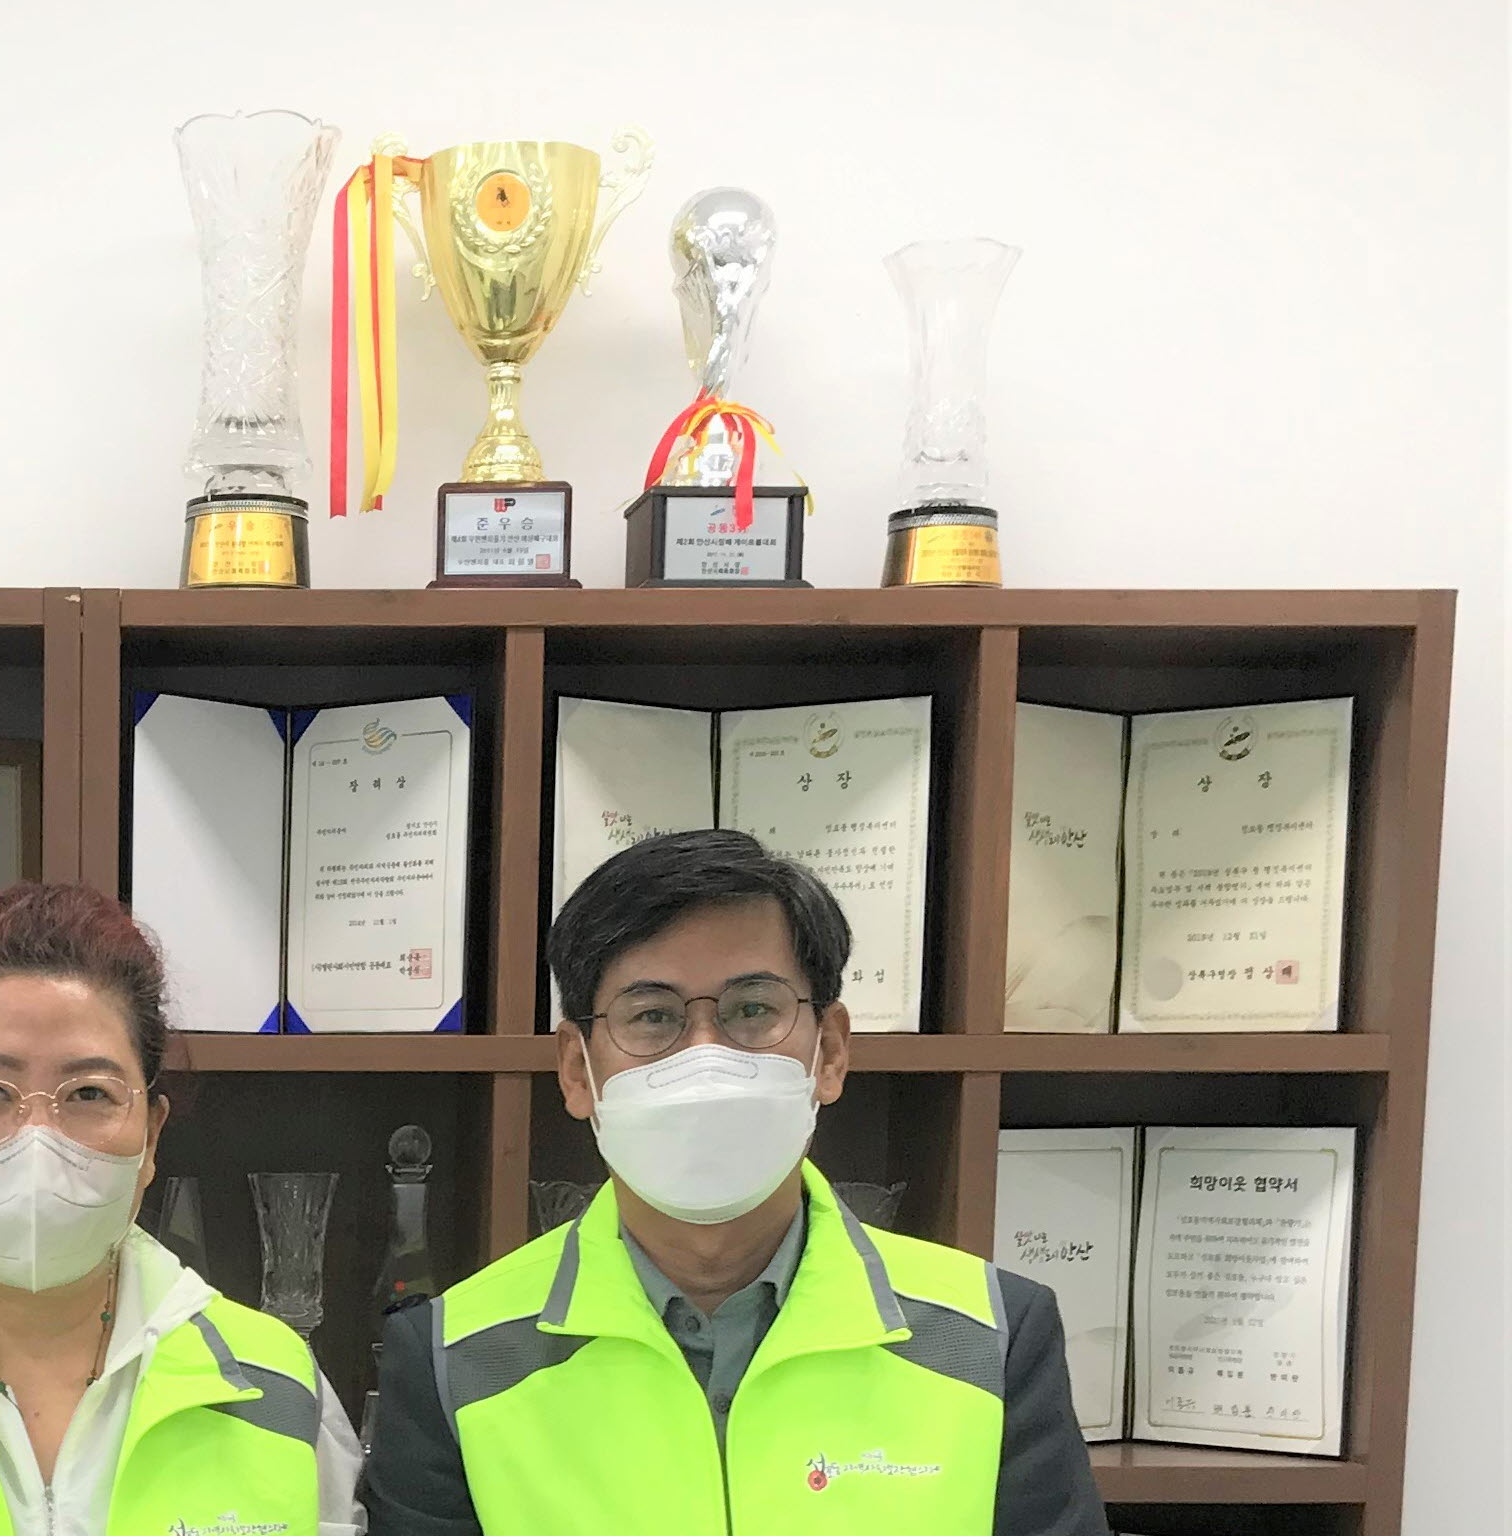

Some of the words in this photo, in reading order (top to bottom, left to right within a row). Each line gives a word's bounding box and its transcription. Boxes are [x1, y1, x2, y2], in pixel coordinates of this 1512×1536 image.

[1189, 1175, 1248, 1192] 희망이웃
[1253, 1176, 1300, 1193] 협약서
[1061, 1241, 1094, 1262] 안산
